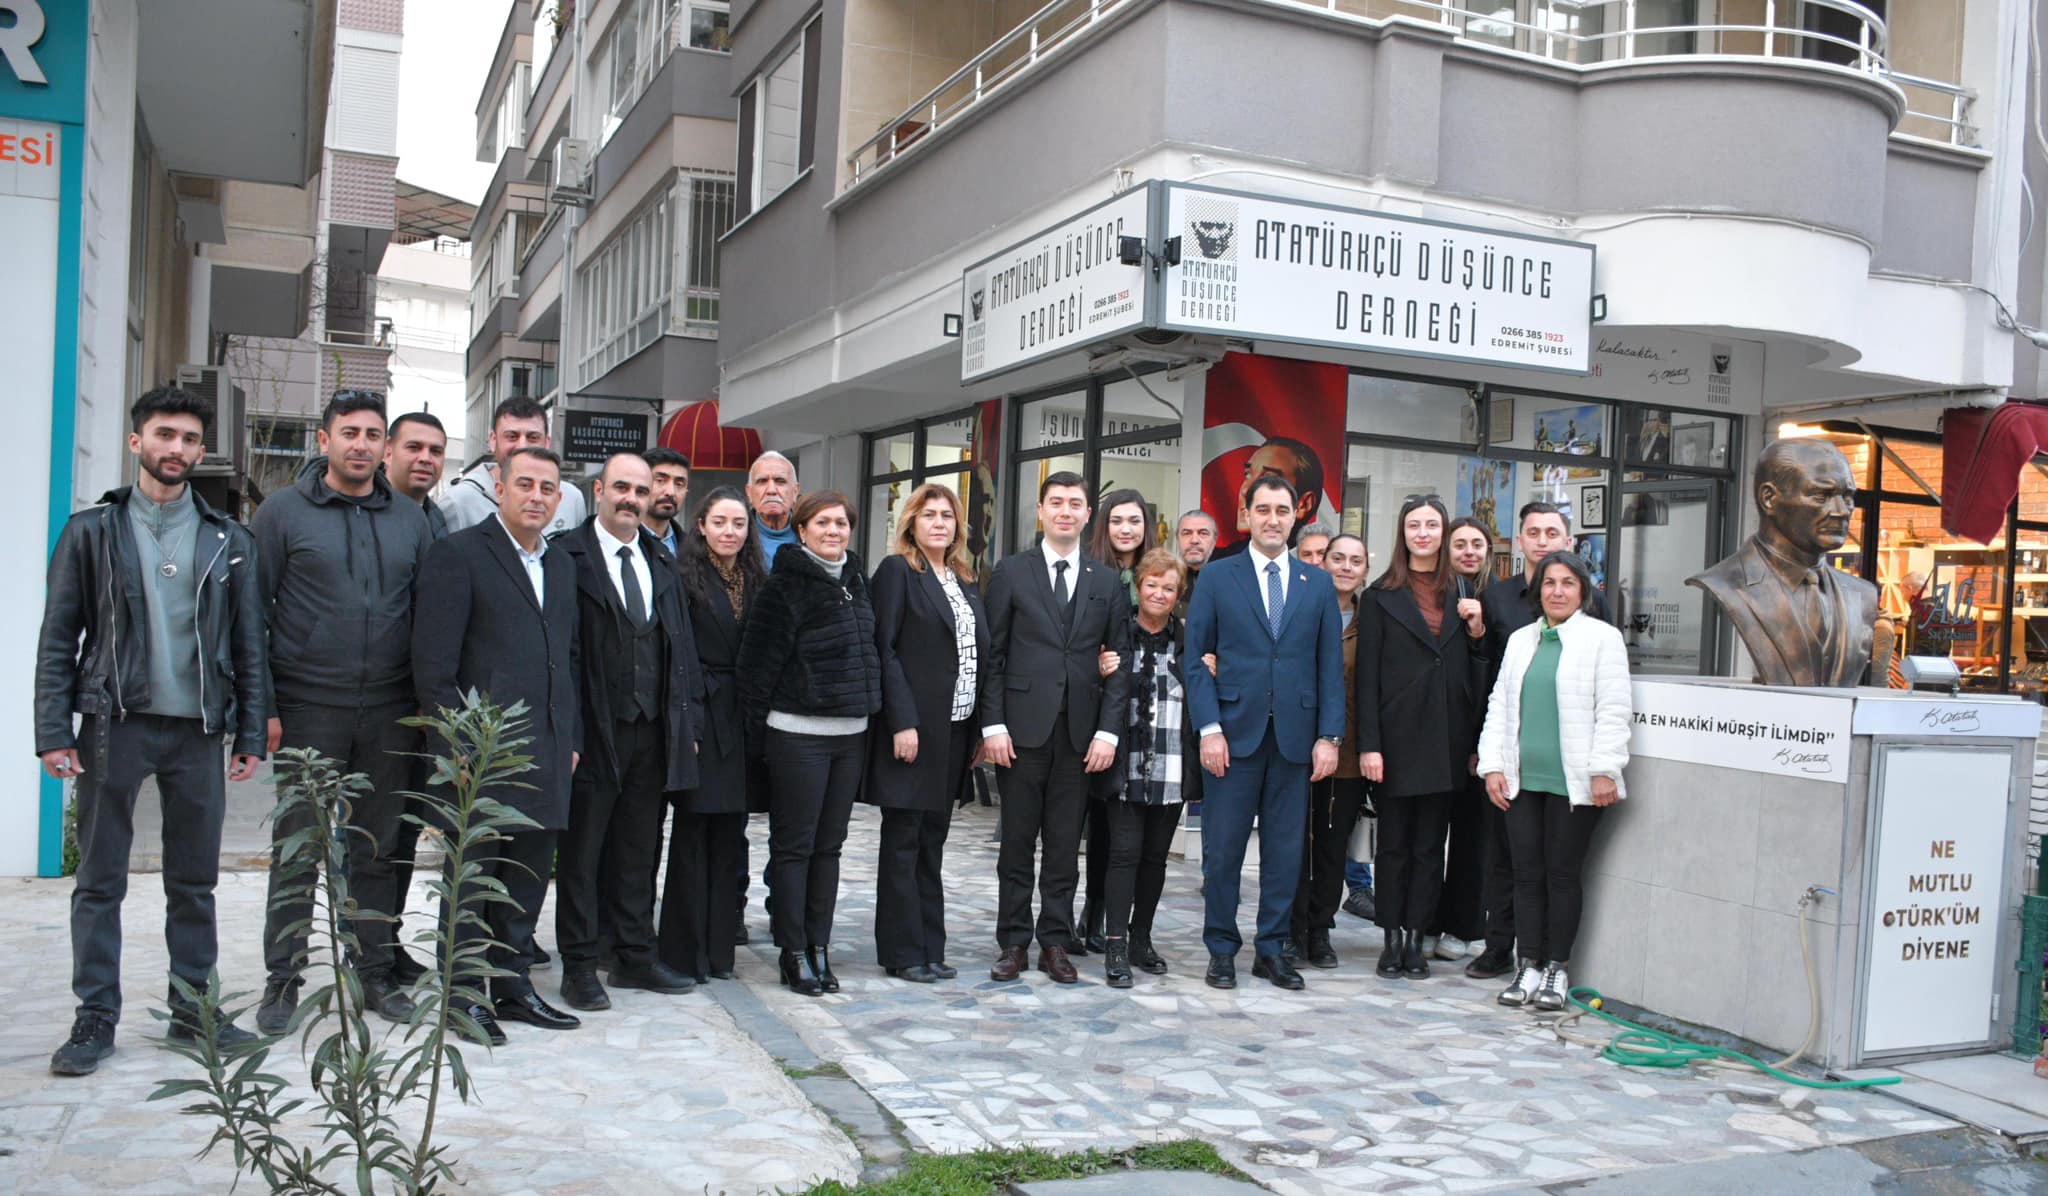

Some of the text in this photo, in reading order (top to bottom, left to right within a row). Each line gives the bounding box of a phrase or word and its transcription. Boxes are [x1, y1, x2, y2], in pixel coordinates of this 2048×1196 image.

[991, 217, 1124, 310] ATATÜRKÇÜ DÜŞÜNCE
[1182, 259, 1237, 282] ATATÜRKÇÜ
[1255, 219, 1551, 299] ATATÜRKÇÜ DÜŞÜNCE
[1094, 298, 1107, 309] 0266
[1118, 290, 1129, 301] 1923
[1181, 278, 1237, 303] DÜŞÜNCE
[1020, 286, 1083, 351] DERNEĞİ
[1181, 299, 1236, 323] DERNEĞİ
[1336, 290, 1477, 346] DERNEĞİ
[1491, 338, 1572, 356] EDREMİT ŞUBESİ
[1501, 326, 1564, 343] 0266 385 1923
[1918, 579, 1975, 631] Ali
[1650, 714, 1666, 726] EN
[1669, 715, 1714, 732] HAKİKİ
[1716, 719, 1767, 740] MÜRŞİT
[1930, 840, 1955, 858] NE
[1909, 873, 1973, 892] MUTLU
[1902, 936, 1970, 961] DİYENE
